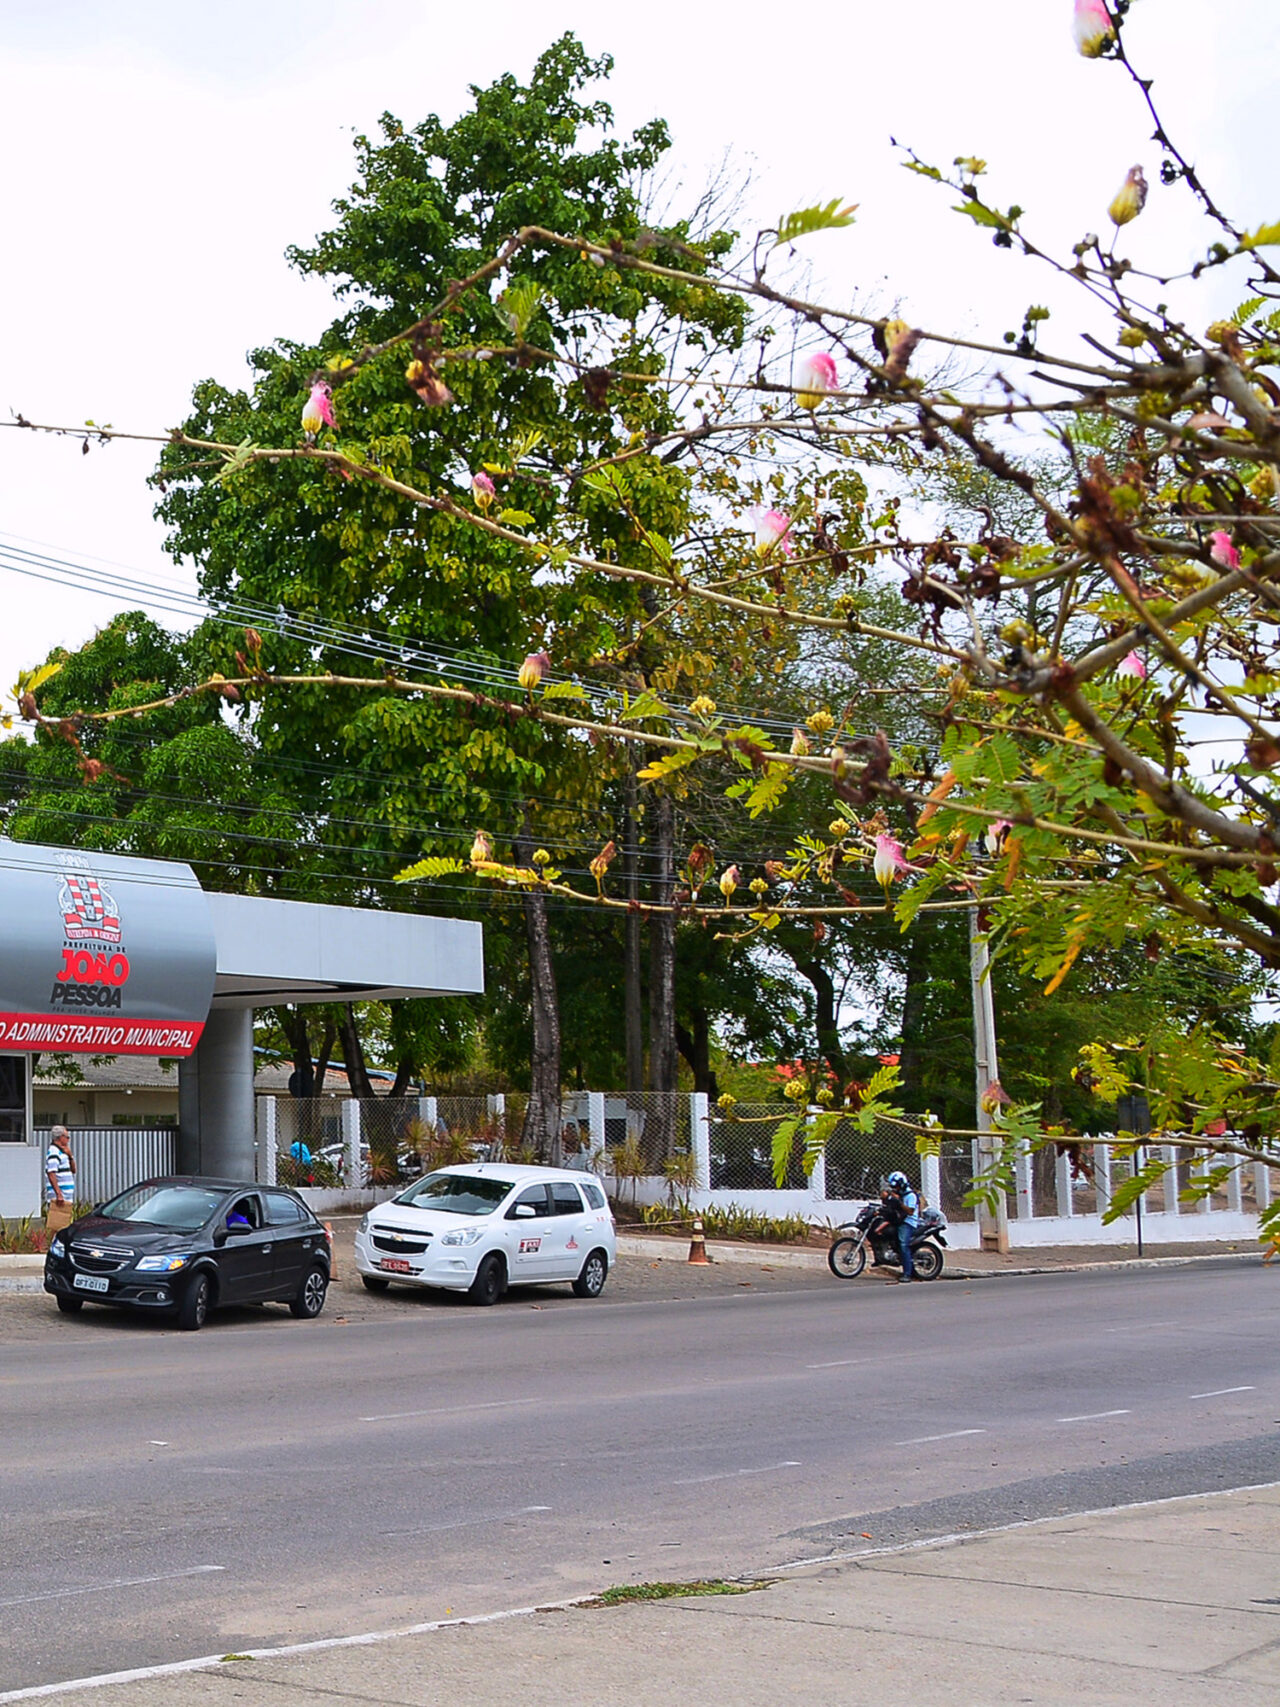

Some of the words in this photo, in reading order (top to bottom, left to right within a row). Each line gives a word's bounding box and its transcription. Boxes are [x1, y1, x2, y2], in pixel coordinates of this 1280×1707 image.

[64, 941, 113, 951] PREFEITURA
[56, 949, 130, 986] JOÃO
[50, 983, 121, 1008] PESSOA
[7, 1023, 125, 1046] ADMINISTRATIVO
[125, 1027, 194, 1049] MUNICIPAL
